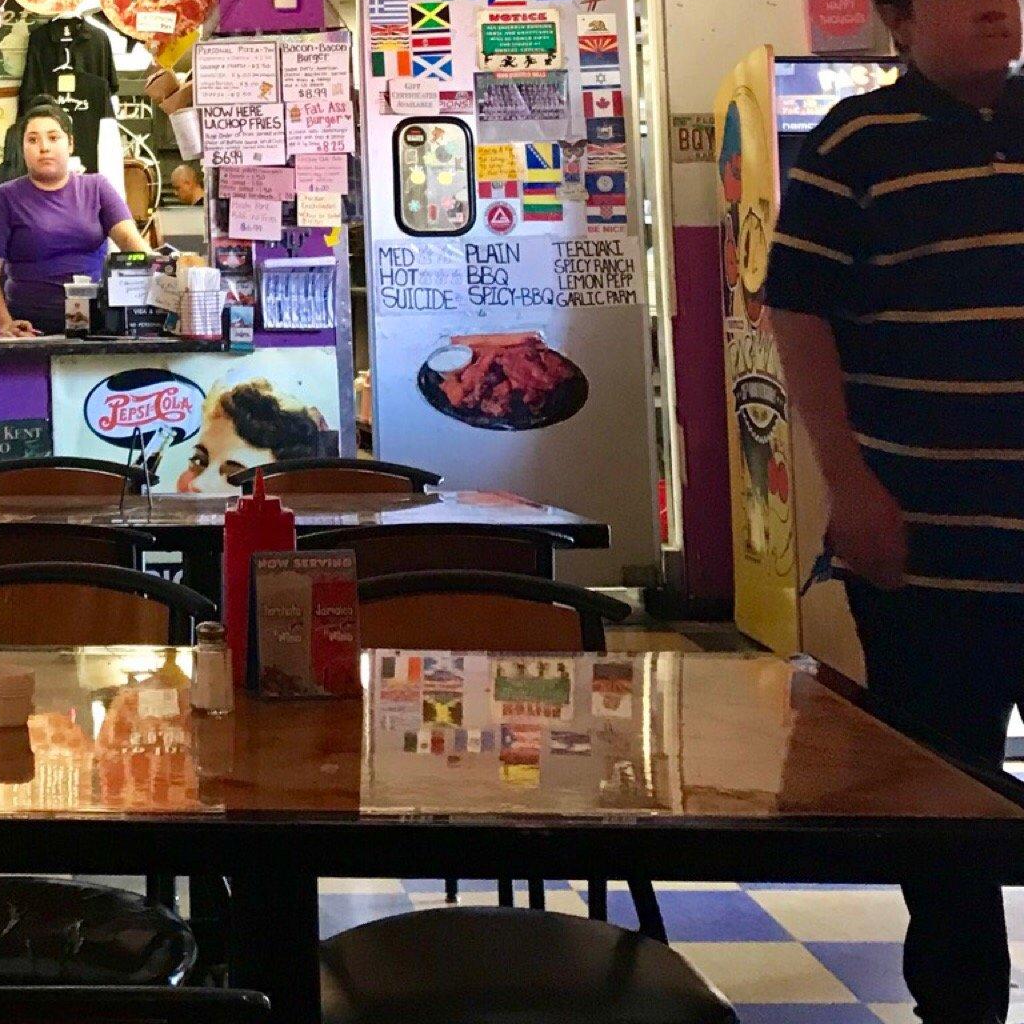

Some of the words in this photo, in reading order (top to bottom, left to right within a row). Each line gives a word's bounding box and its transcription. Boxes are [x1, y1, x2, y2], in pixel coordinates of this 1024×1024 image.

[489, 13, 547, 21] NOTICE
[204, 107, 234, 118] NOW
[236, 106, 263, 116] HERE
[249, 117, 281, 129] FRIES
[465, 243, 520, 264] PLAIN
[552, 240, 623, 256] TERIYAKI
[379, 248, 415, 267] MED
[554, 260, 590, 273] SPICY
[594, 260, 634, 273] RANCH
[380, 269, 419, 286] HOT
[467, 266, 509, 285] BBQ
[558, 276, 604, 290] LEMON
[381, 288, 457, 310] SUICIDE
[468, 287, 555, 306] SPICY-BBQ
[557, 290, 604, 307] GARLIC
[607, 290, 636, 304] PARM
[258, 559, 288, 568] NOW
[294, 558, 351, 568] SERVING
